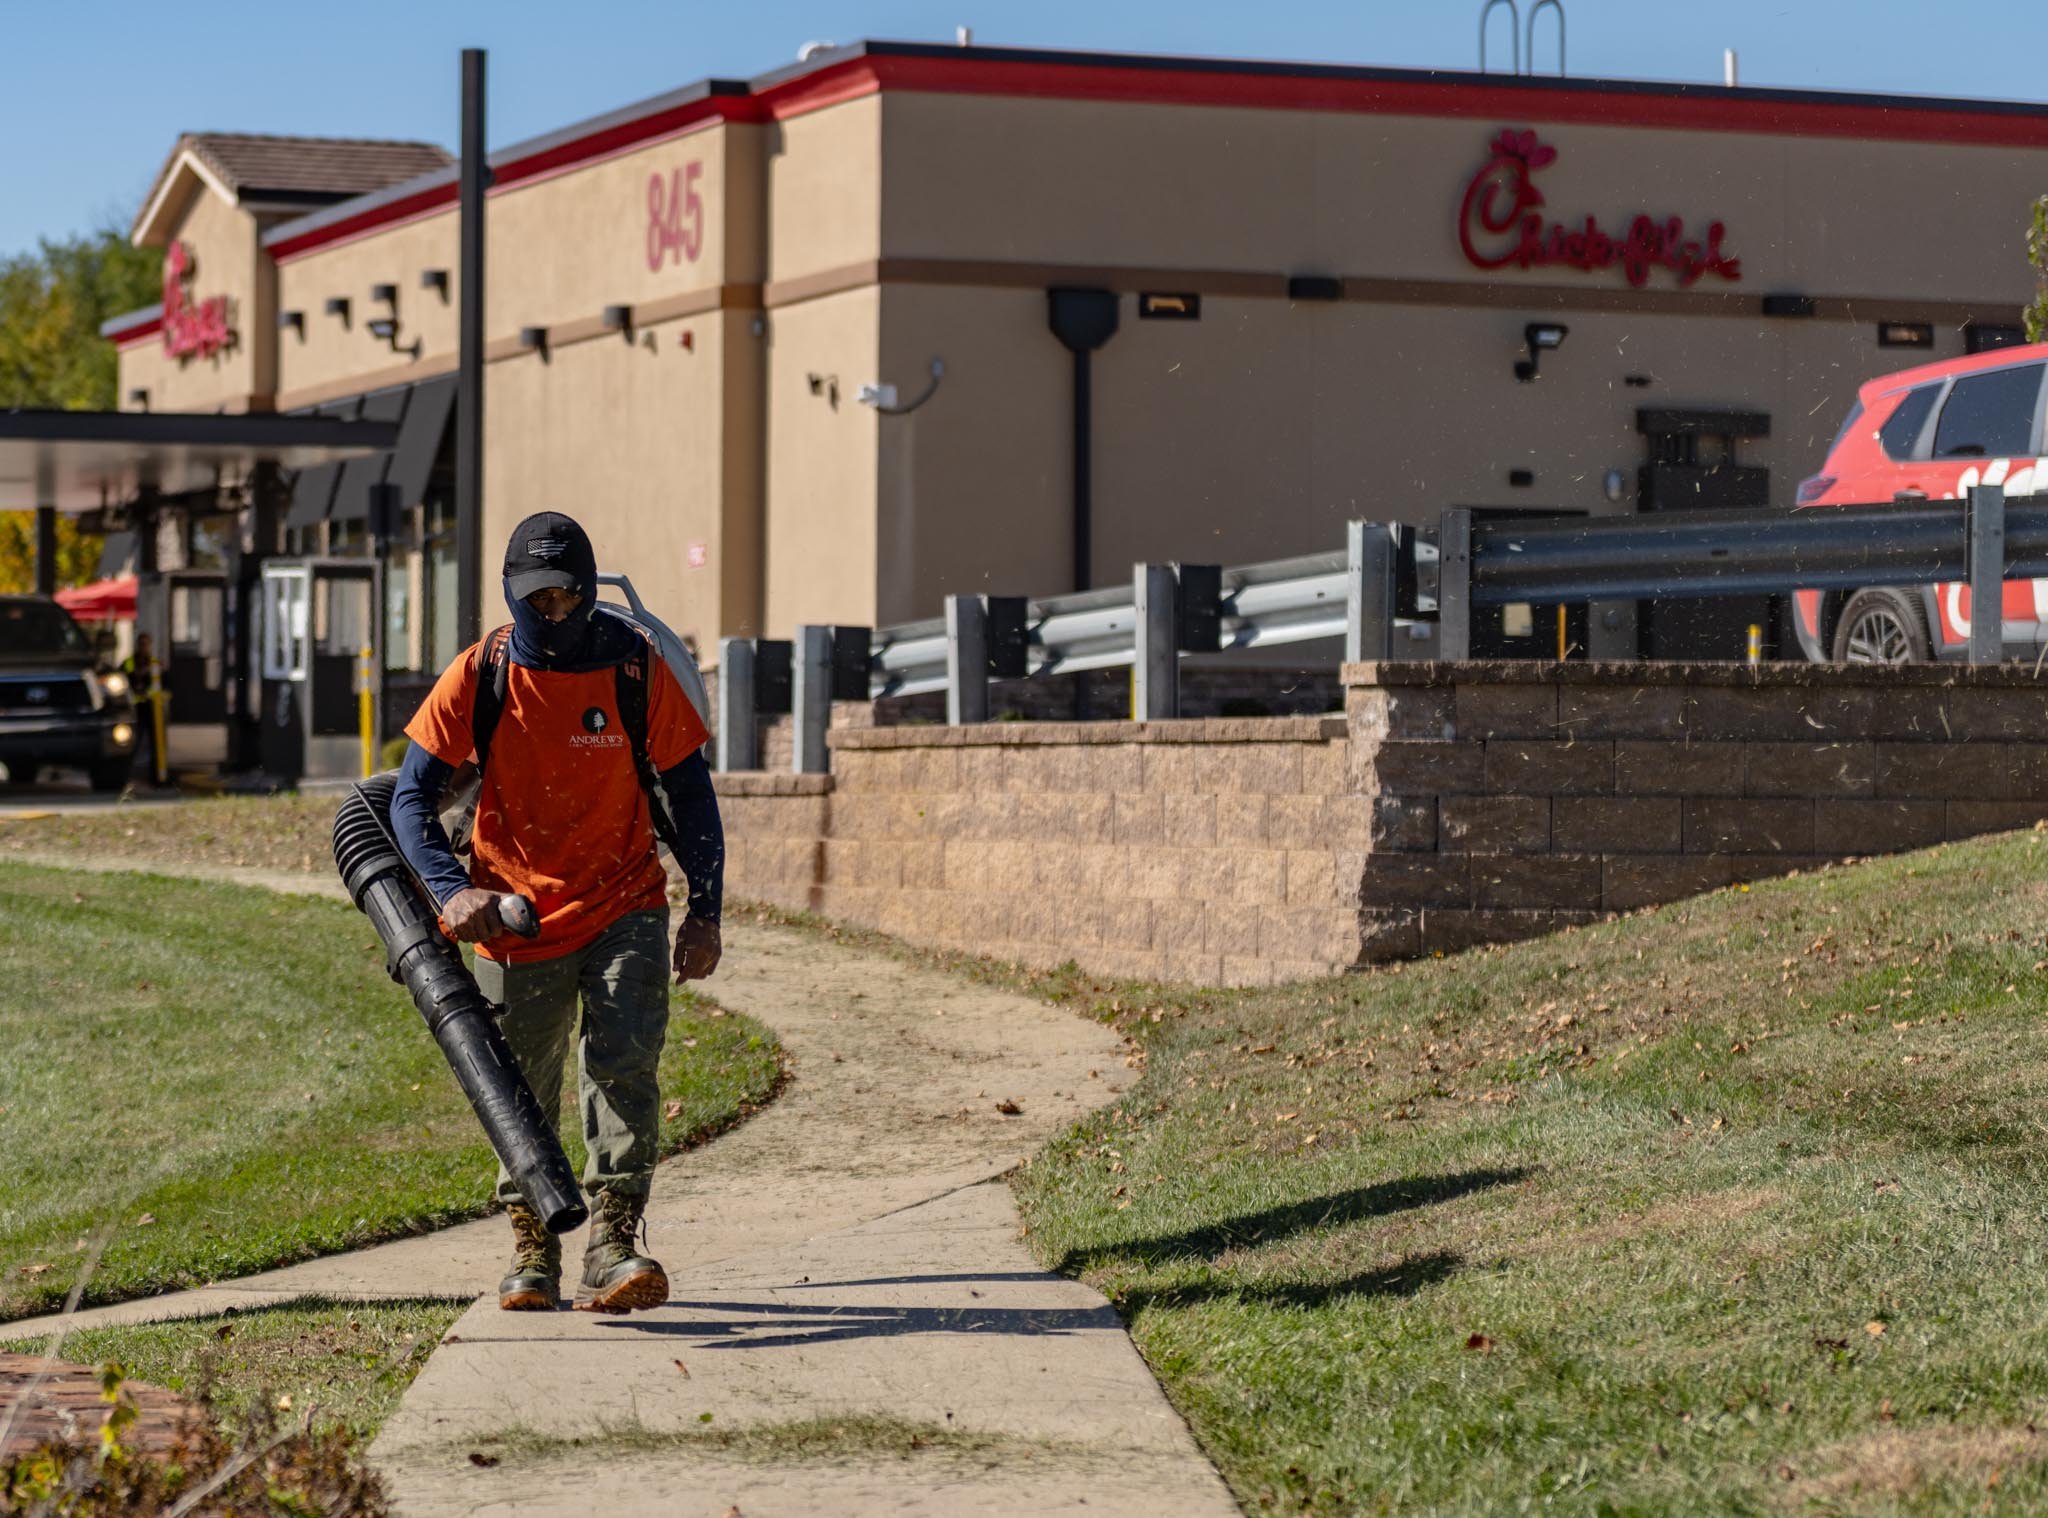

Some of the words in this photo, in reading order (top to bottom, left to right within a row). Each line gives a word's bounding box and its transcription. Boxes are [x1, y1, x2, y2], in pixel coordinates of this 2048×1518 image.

[647, 160, 704, 272] 845
[1459, 128, 1742, 288] Chick-fil-A
[569, 735, 624, 744] ANDREW'S
